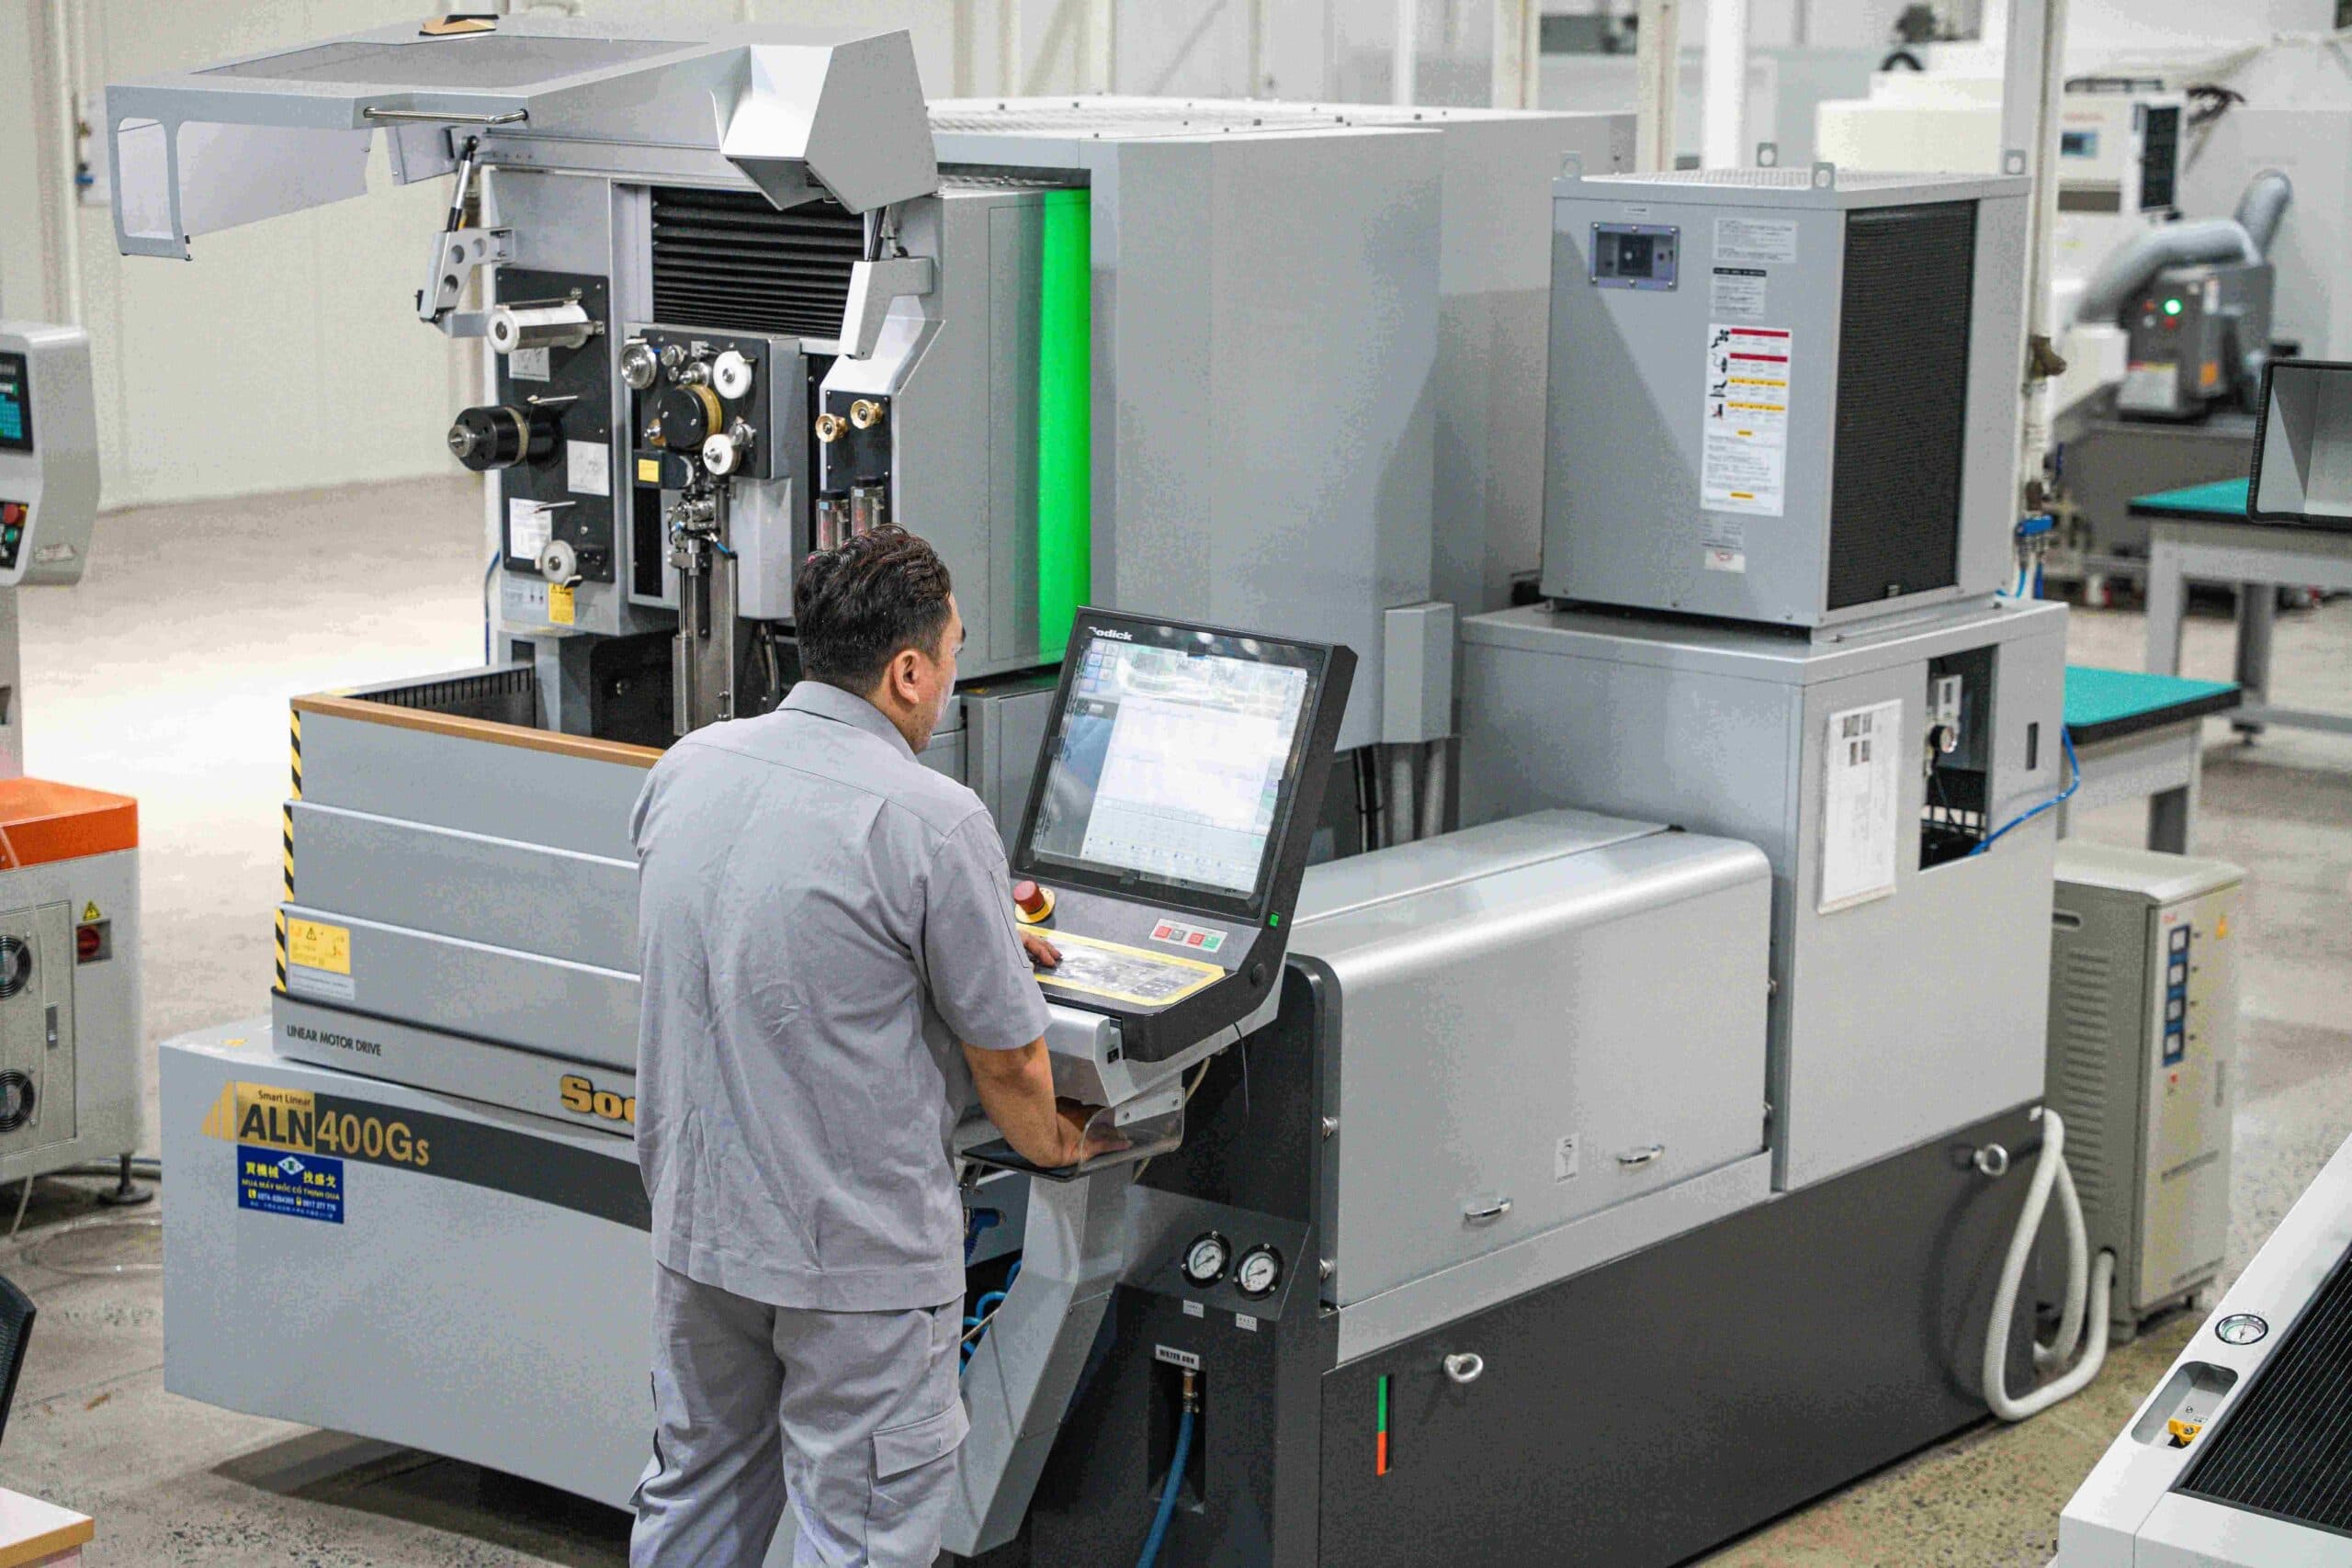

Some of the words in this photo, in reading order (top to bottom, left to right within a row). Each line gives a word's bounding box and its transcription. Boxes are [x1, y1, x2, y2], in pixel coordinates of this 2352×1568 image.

[287, 1024, 318, 1043] LINEAR
[320, 1030, 354, 1050] MOTOR
[356, 1039, 382, 1056] DRIVE
[258, 1090, 283, 1103] Smart
[285, 1095, 311, 1107] Linear
